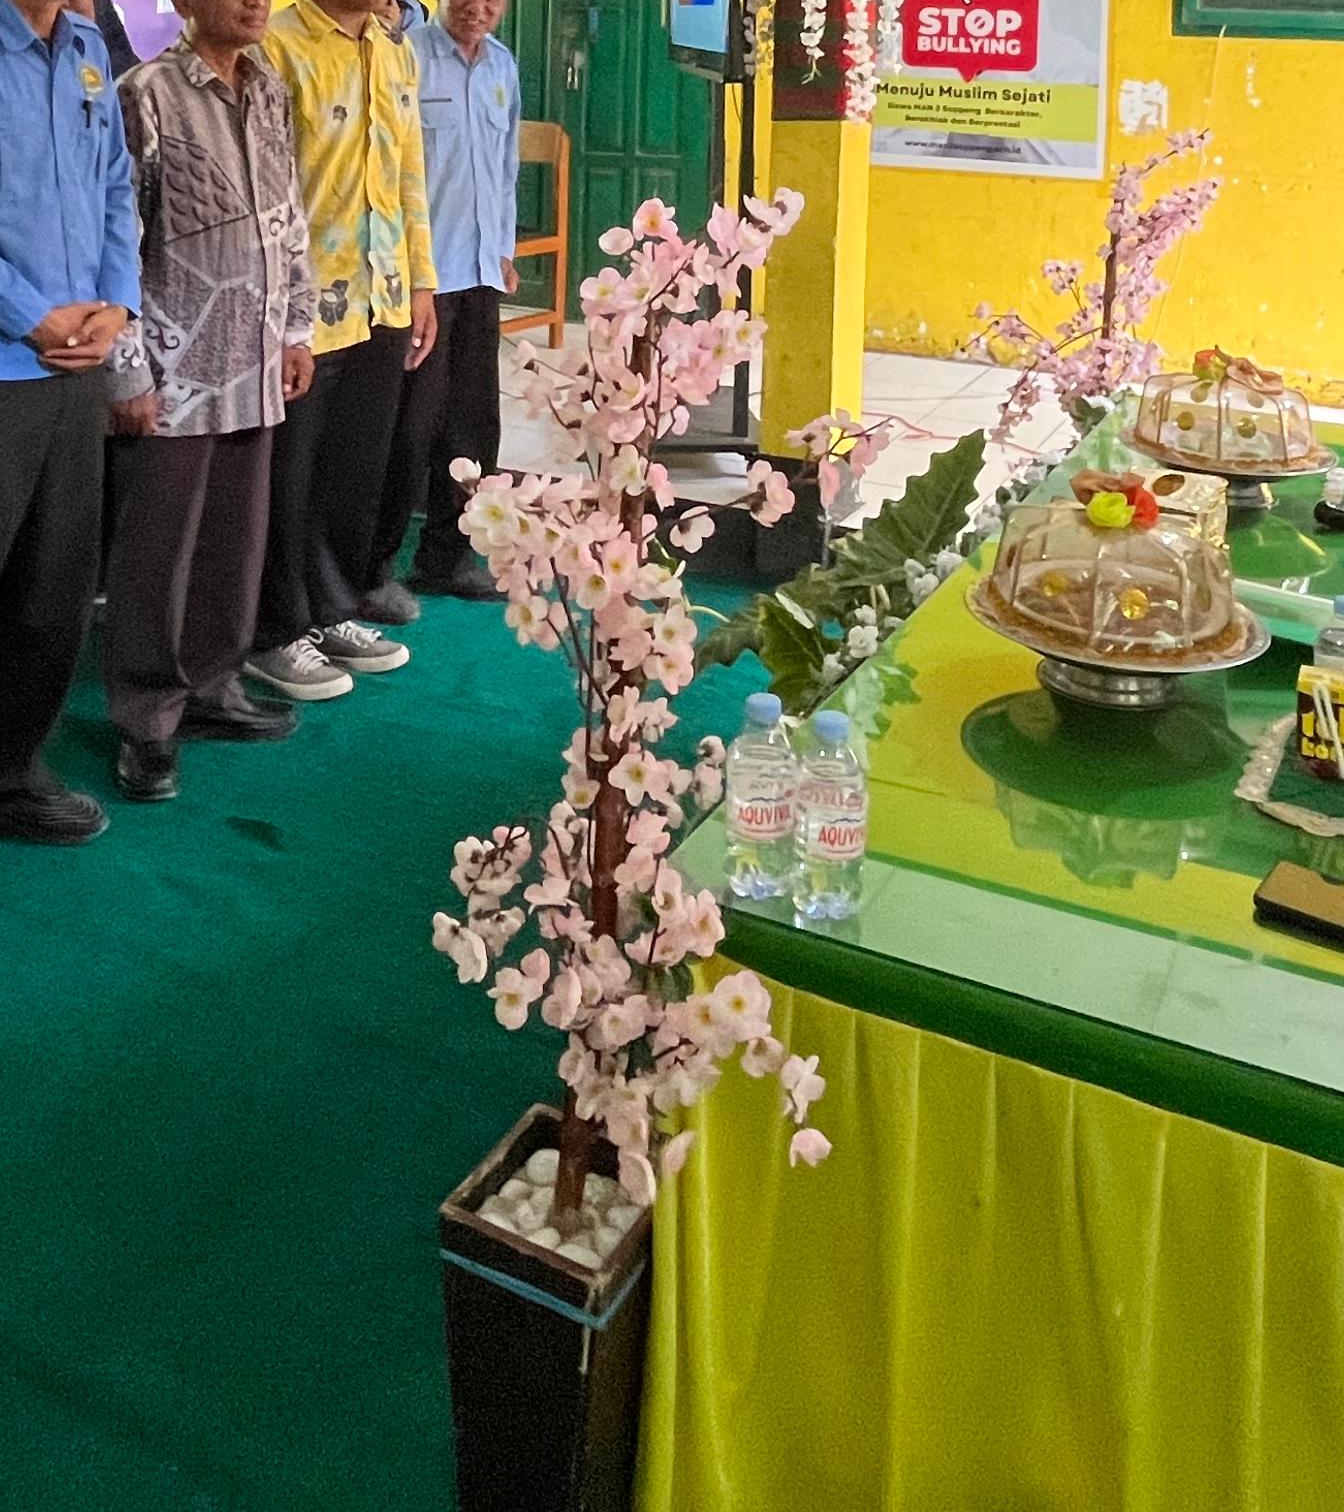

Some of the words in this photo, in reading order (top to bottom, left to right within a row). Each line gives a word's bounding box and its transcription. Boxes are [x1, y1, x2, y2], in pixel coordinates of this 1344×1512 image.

[918, 6, 1022, 38] STOP
[917, 35, 1021, 56] BULLYING
[876, 82, 935, 100] Menuju
[938, 85, 998, 101] Muslim
[1002, 88, 1051, 105] Sejati
